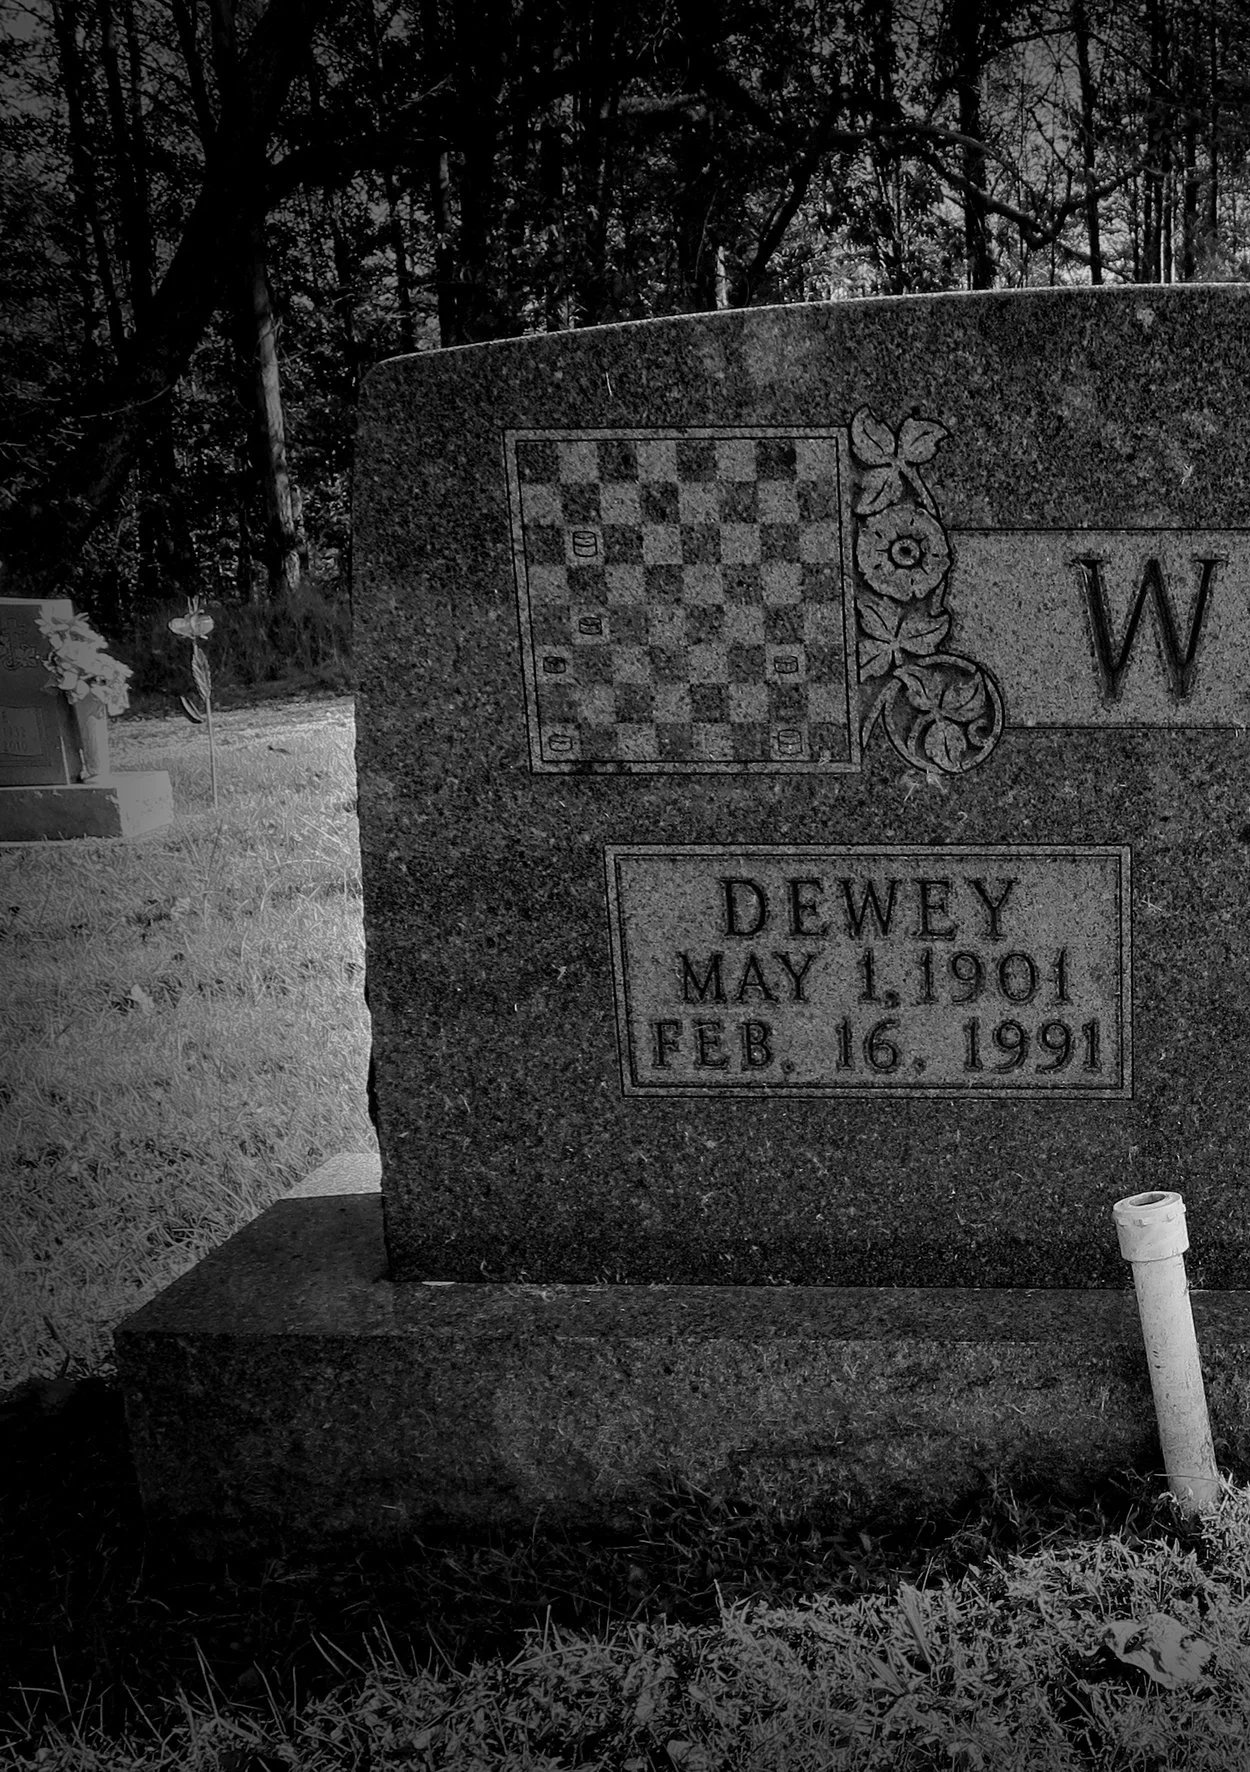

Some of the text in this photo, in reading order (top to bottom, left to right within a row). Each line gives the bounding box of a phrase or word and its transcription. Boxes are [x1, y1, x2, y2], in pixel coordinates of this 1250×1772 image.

[722, 876, 1020, 940] DEWEY
[678, 949, 820, 1004] MAY
[650, 1018, 797, 1075] FEB.
[960, 1014, 1101, 1074] 1991
